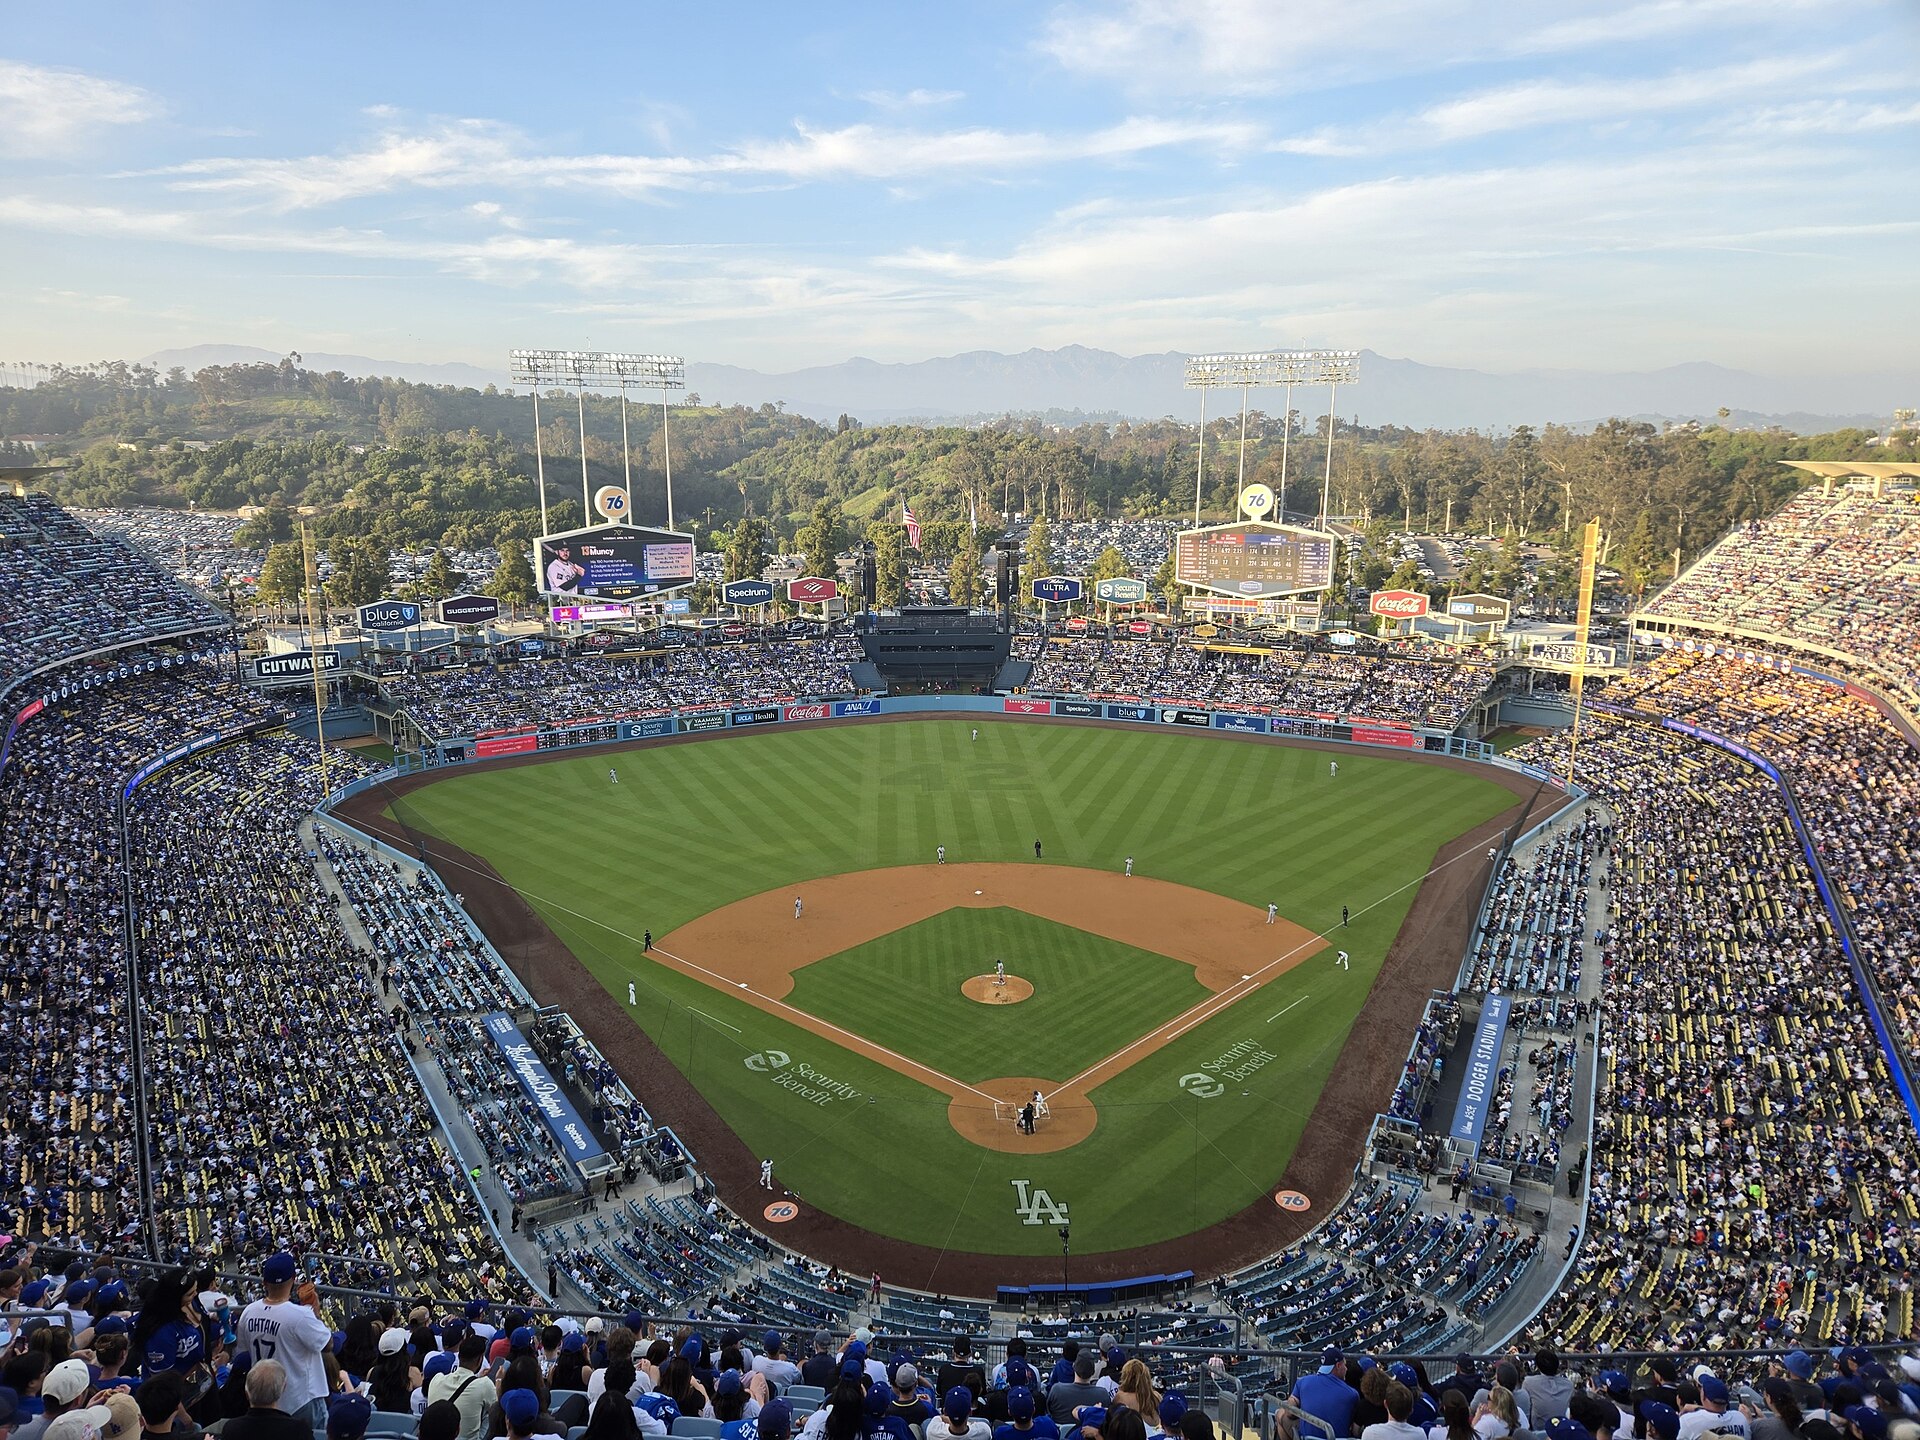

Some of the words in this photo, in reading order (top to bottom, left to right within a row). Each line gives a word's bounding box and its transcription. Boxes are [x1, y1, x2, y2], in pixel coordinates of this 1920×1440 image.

[606, 495, 624, 509] 76
[1248, 493, 1265, 506] 76
[1244, 525, 1263, 533] 6:38
[581, 545, 590, 556] 13
[589, 548, 614, 556] Muncy
[729, 588, 767, 599] Spectrum
[1114, 584, 1140, 593] Security
[1114, 591, 1138, 599] Benefit
[447, 606, 495, 615] GUGGENHEIM
[1375, 596, 1422, 613] Coca-Cola
[1475, 605, 1503, 615] Health
[366, 608, 399, 622] blue
[372, 619, 404, 627] california
[261, 655, 334, 674] CUTWATER
[788, 705, 825, 719] Coca-Cola
[845, 703, 863, 711] ANA
[1118, 708, 1137, 716] blue
[755, 712, 775, 720] Health
[1224, 723, 1256, 732] Budweiser
[1477, 1022, 1498, 1060] STADIUM
[1200, 1038, 1262, 1073] Security
[1221, 1050, 1278, 1082] Benefit
[791, 1063, 862, 1100] Security
[1466, 1062, 1489, 1102] DODGER
[771, 1072, 834, 1107] Benefit
[534, 1082, 566, 1119] Dodgers
[564, 1123, 585, 1149] Spectrum
[1011, 1180, 1070, 1225] LA
[1282, 1195, 1305, 1207] 76
[770, 1205, 793, 1217] 76
[248, 1318, 281, 1337] OHTANI
[253, 1338, 276, 1360] 17
